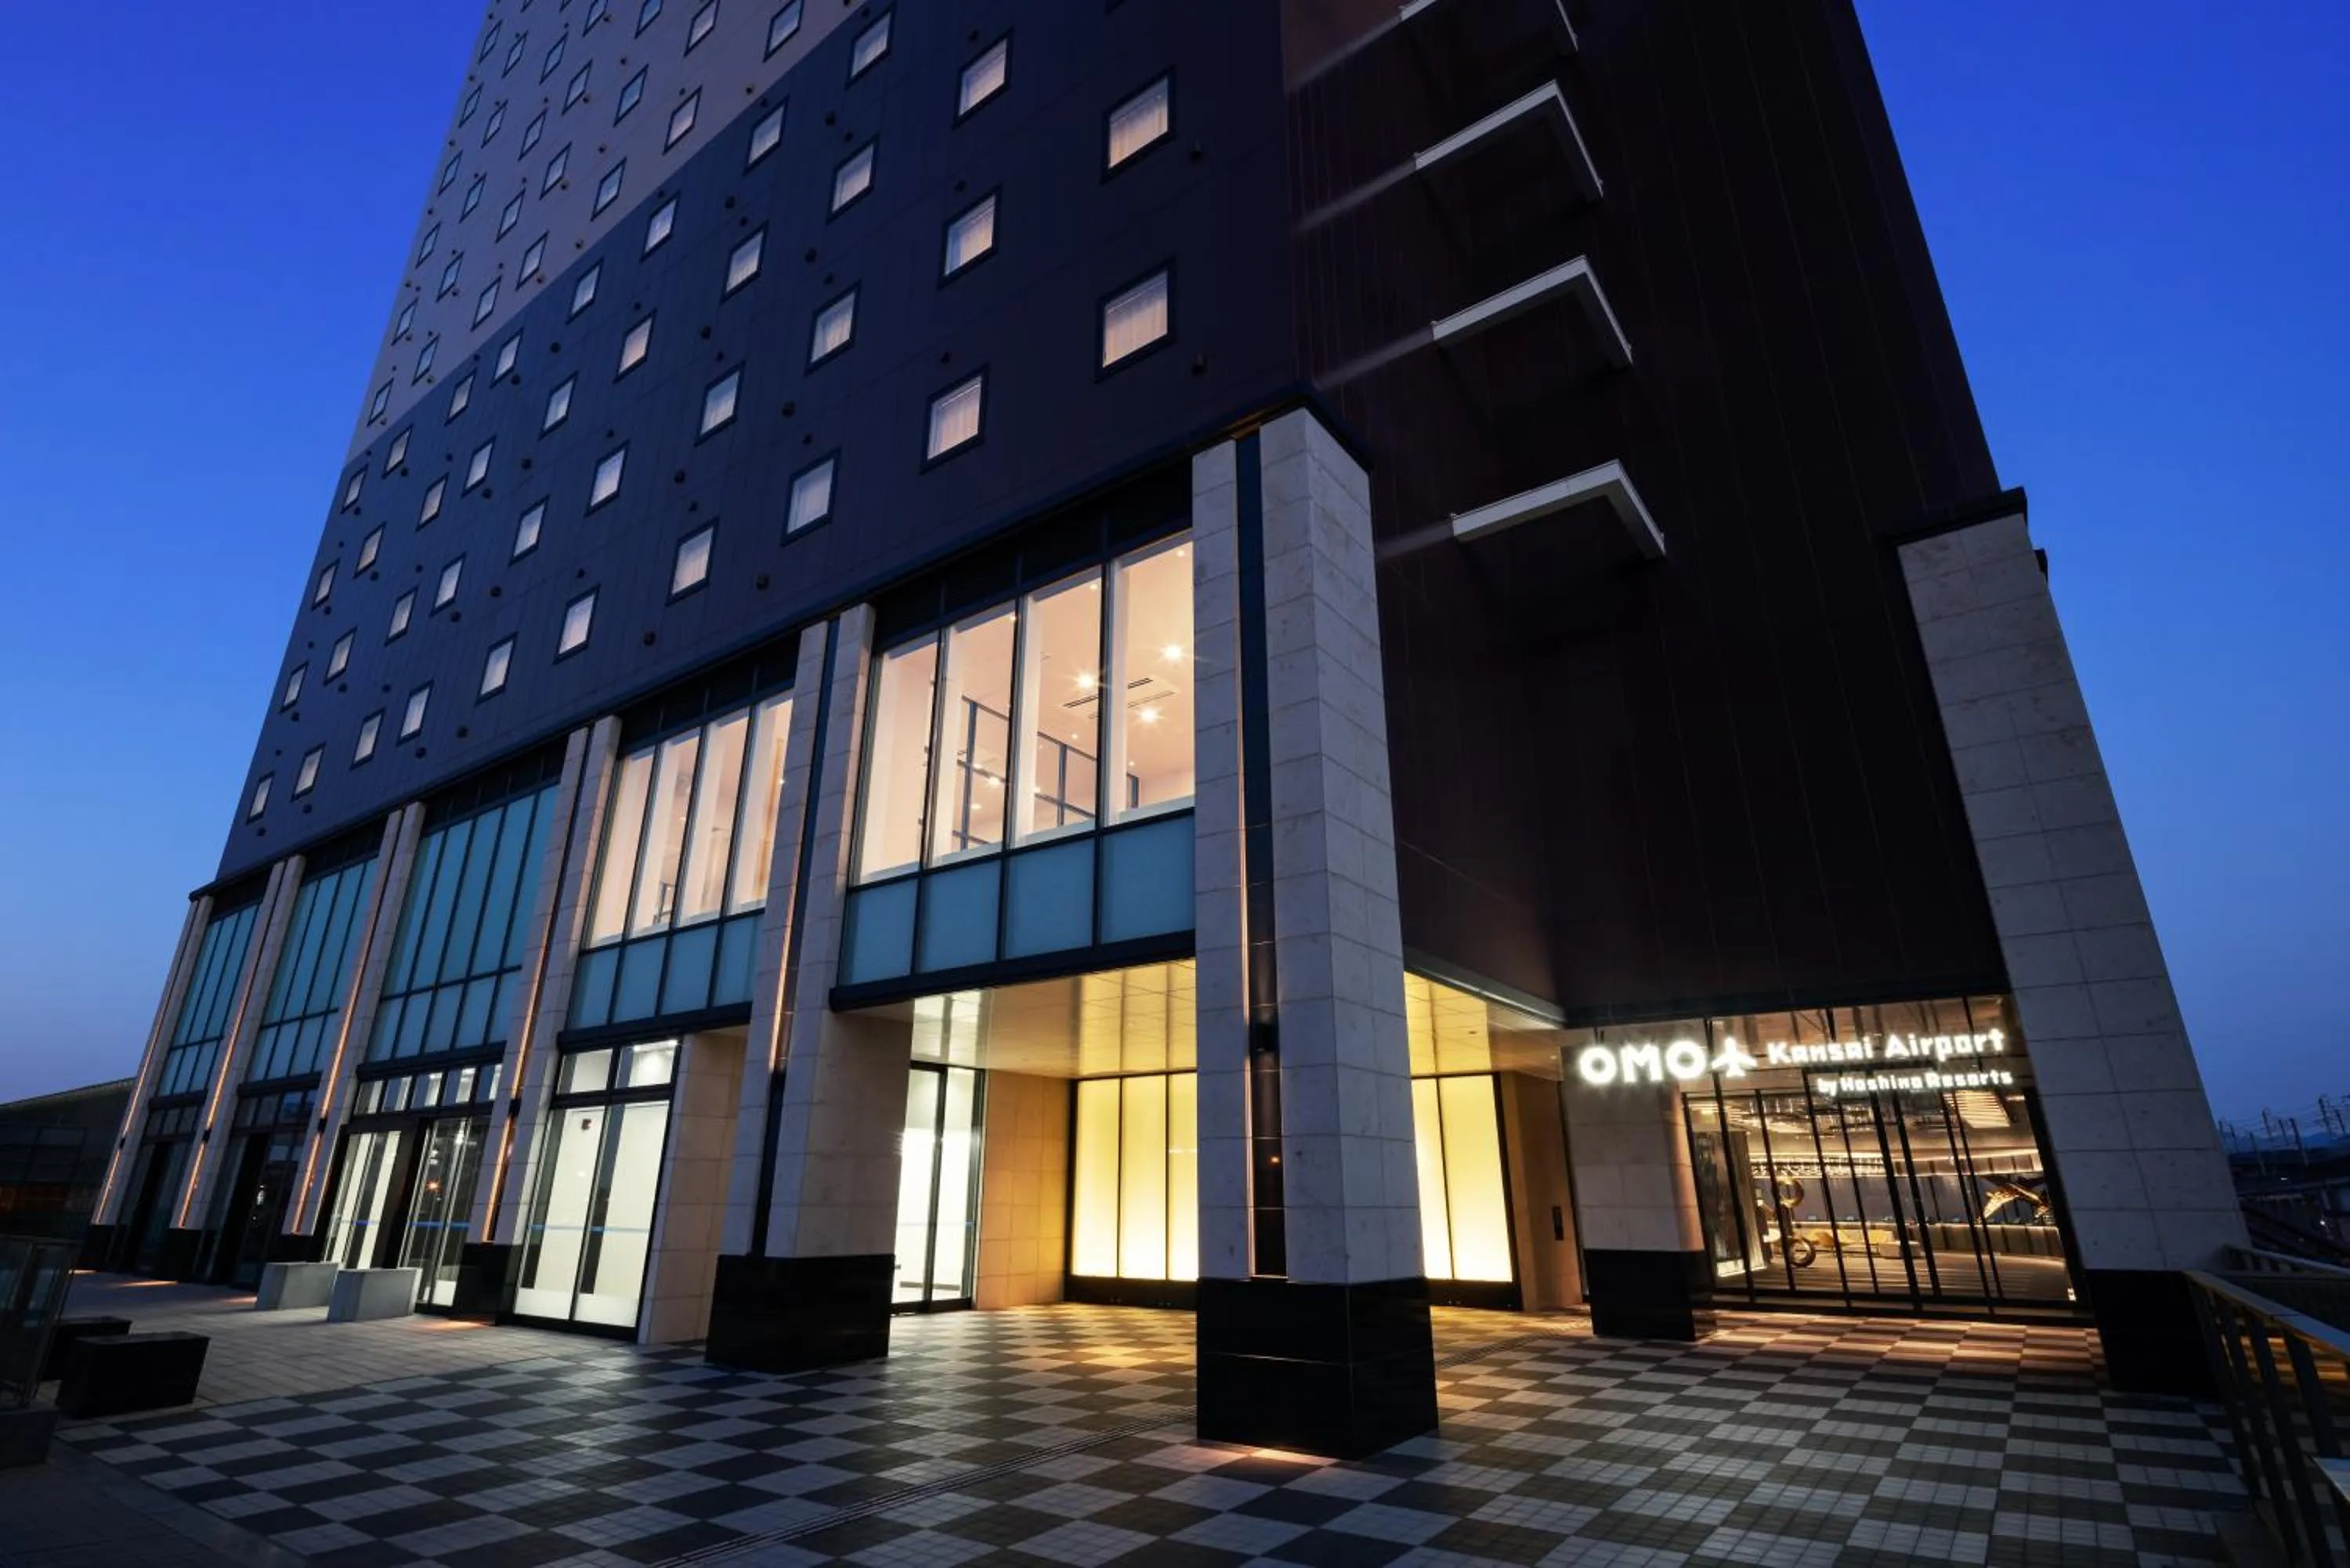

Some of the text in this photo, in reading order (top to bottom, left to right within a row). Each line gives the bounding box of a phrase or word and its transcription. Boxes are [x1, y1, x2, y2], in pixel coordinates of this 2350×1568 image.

[1579, 1028, 2005, 1084] OMO Kansai Airport
[1817, 1070, 2013, 1097] by Hoshino Resorts
